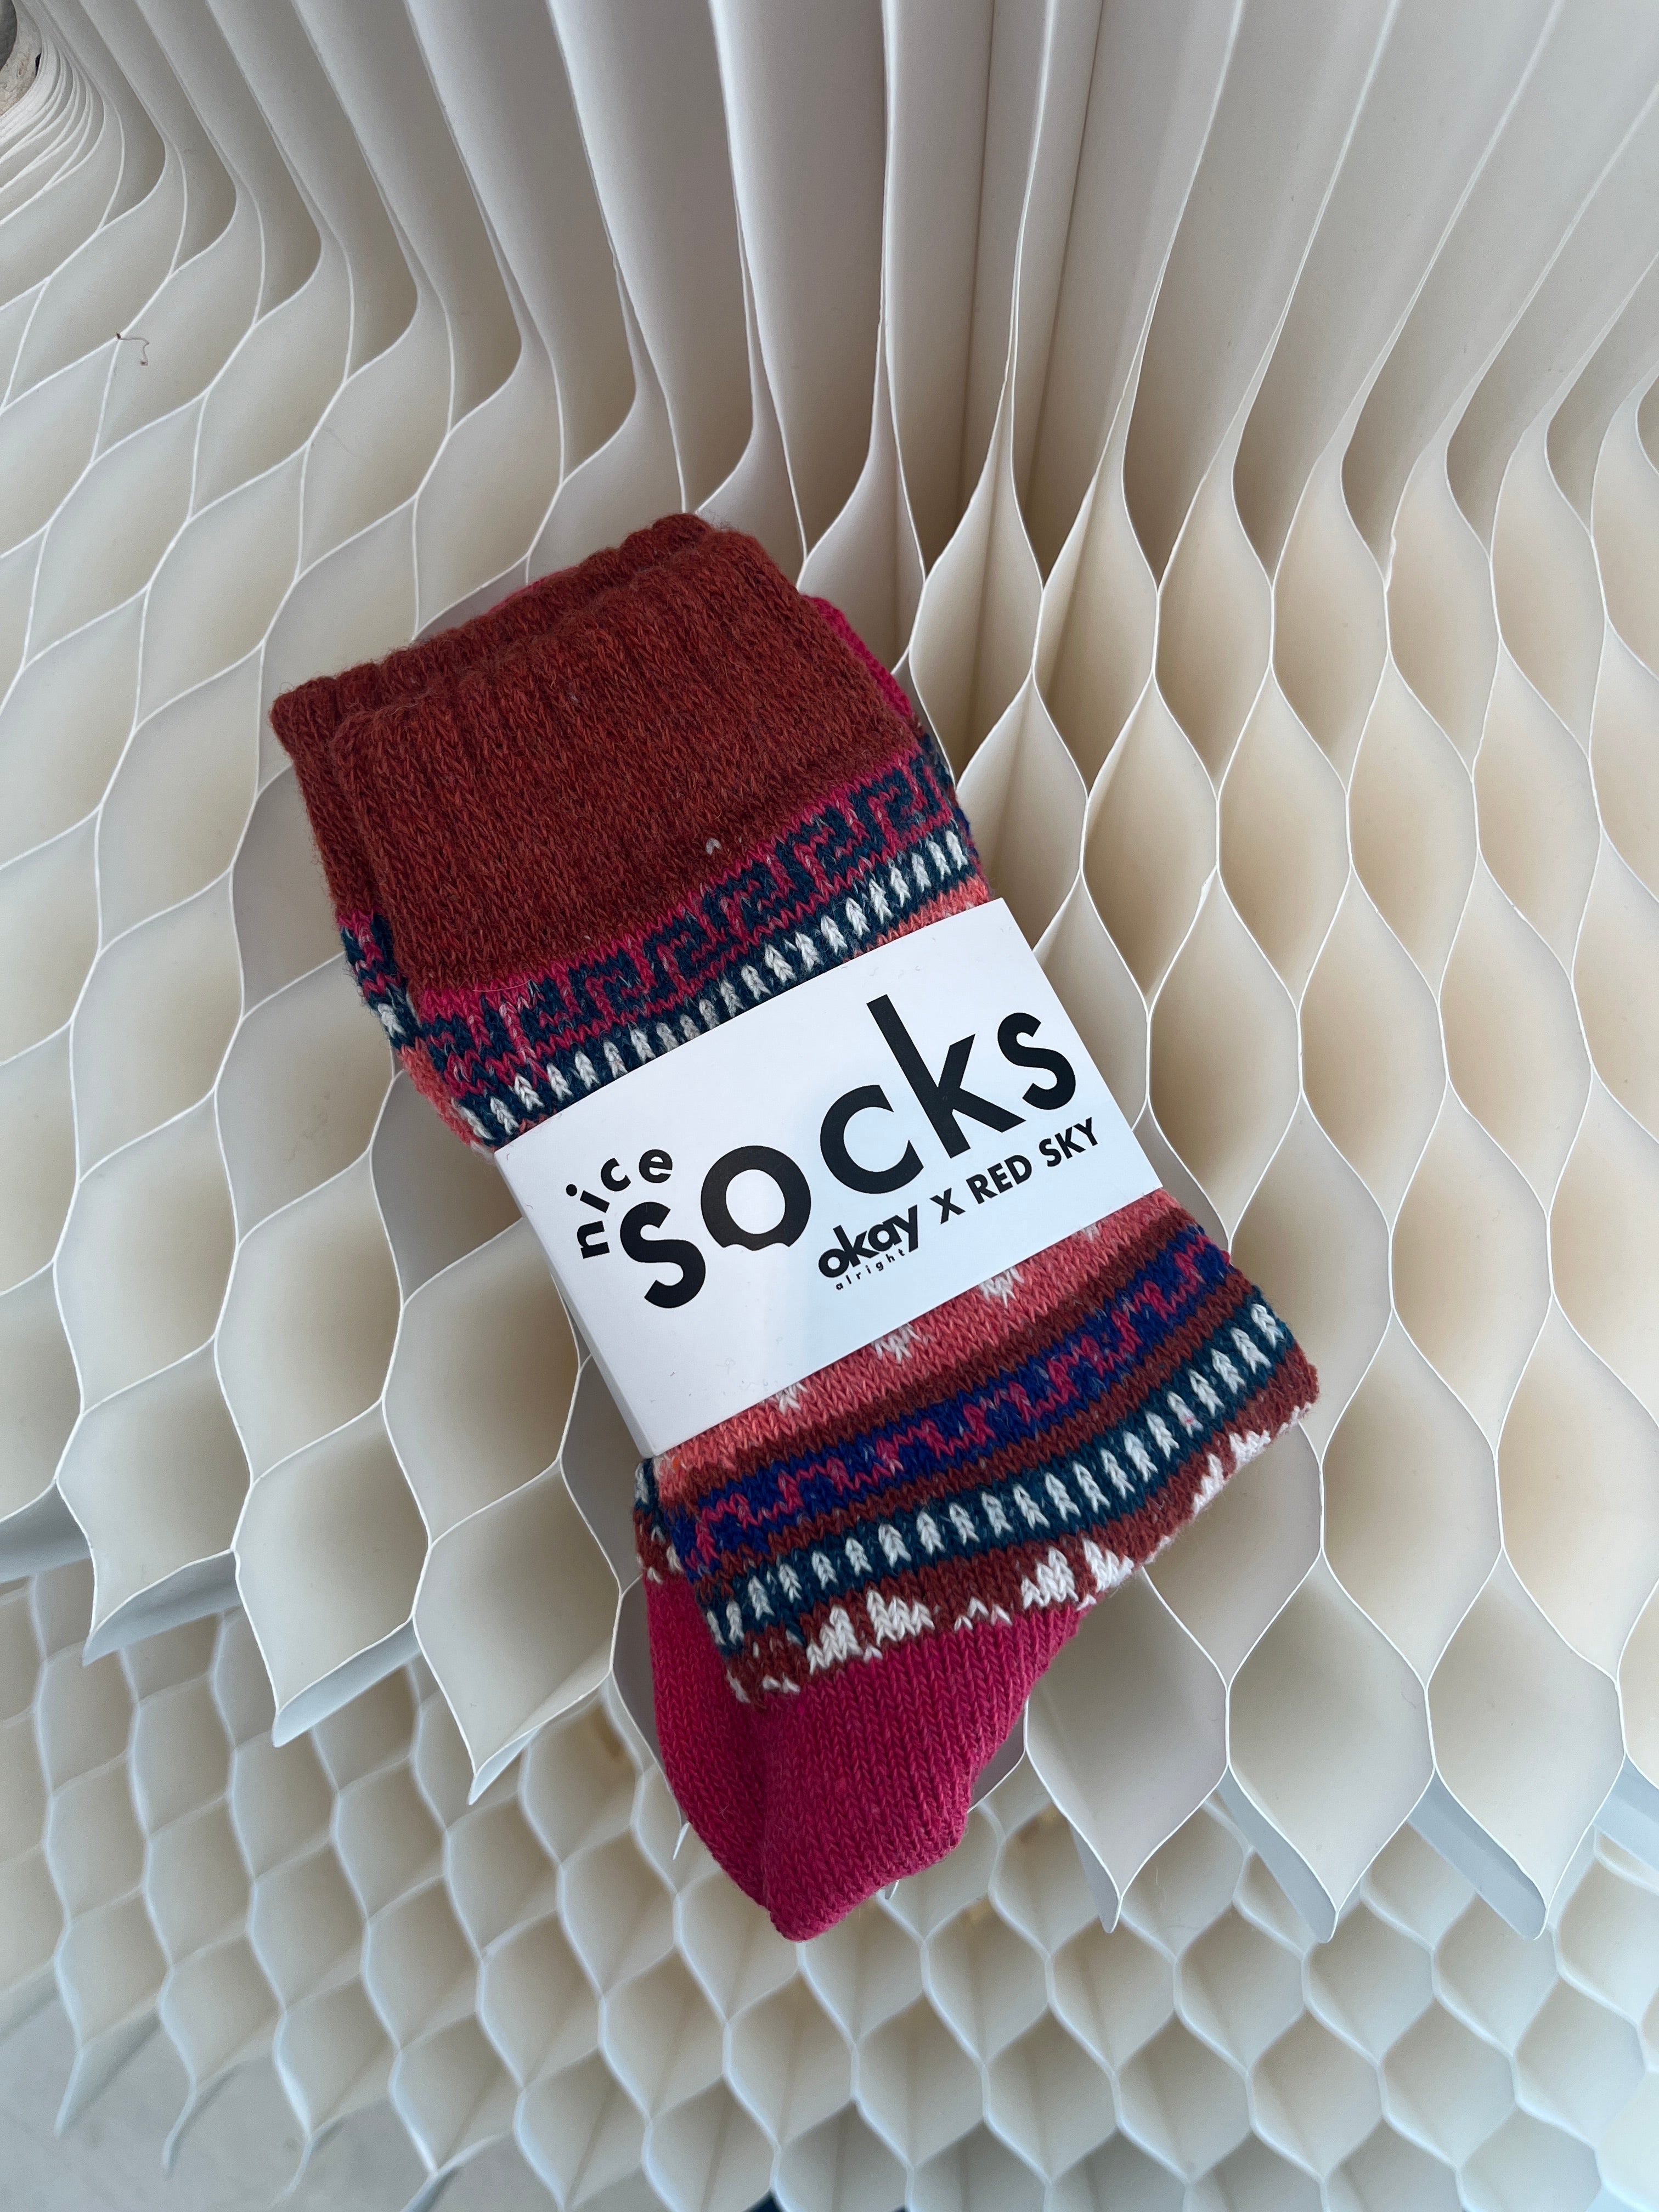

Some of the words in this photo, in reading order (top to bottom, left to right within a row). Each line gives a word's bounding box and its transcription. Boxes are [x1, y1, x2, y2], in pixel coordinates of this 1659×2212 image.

[565, 1148, 674, 1260] nice
[817, 1204, 919, 1279] okay
[929, 1187, 966, 1225] X
[965, 1154, 1032, 1205] RED
[1038, 1116, 1099, 1167] SKY
[834, 1248, 906, 1291] alright
